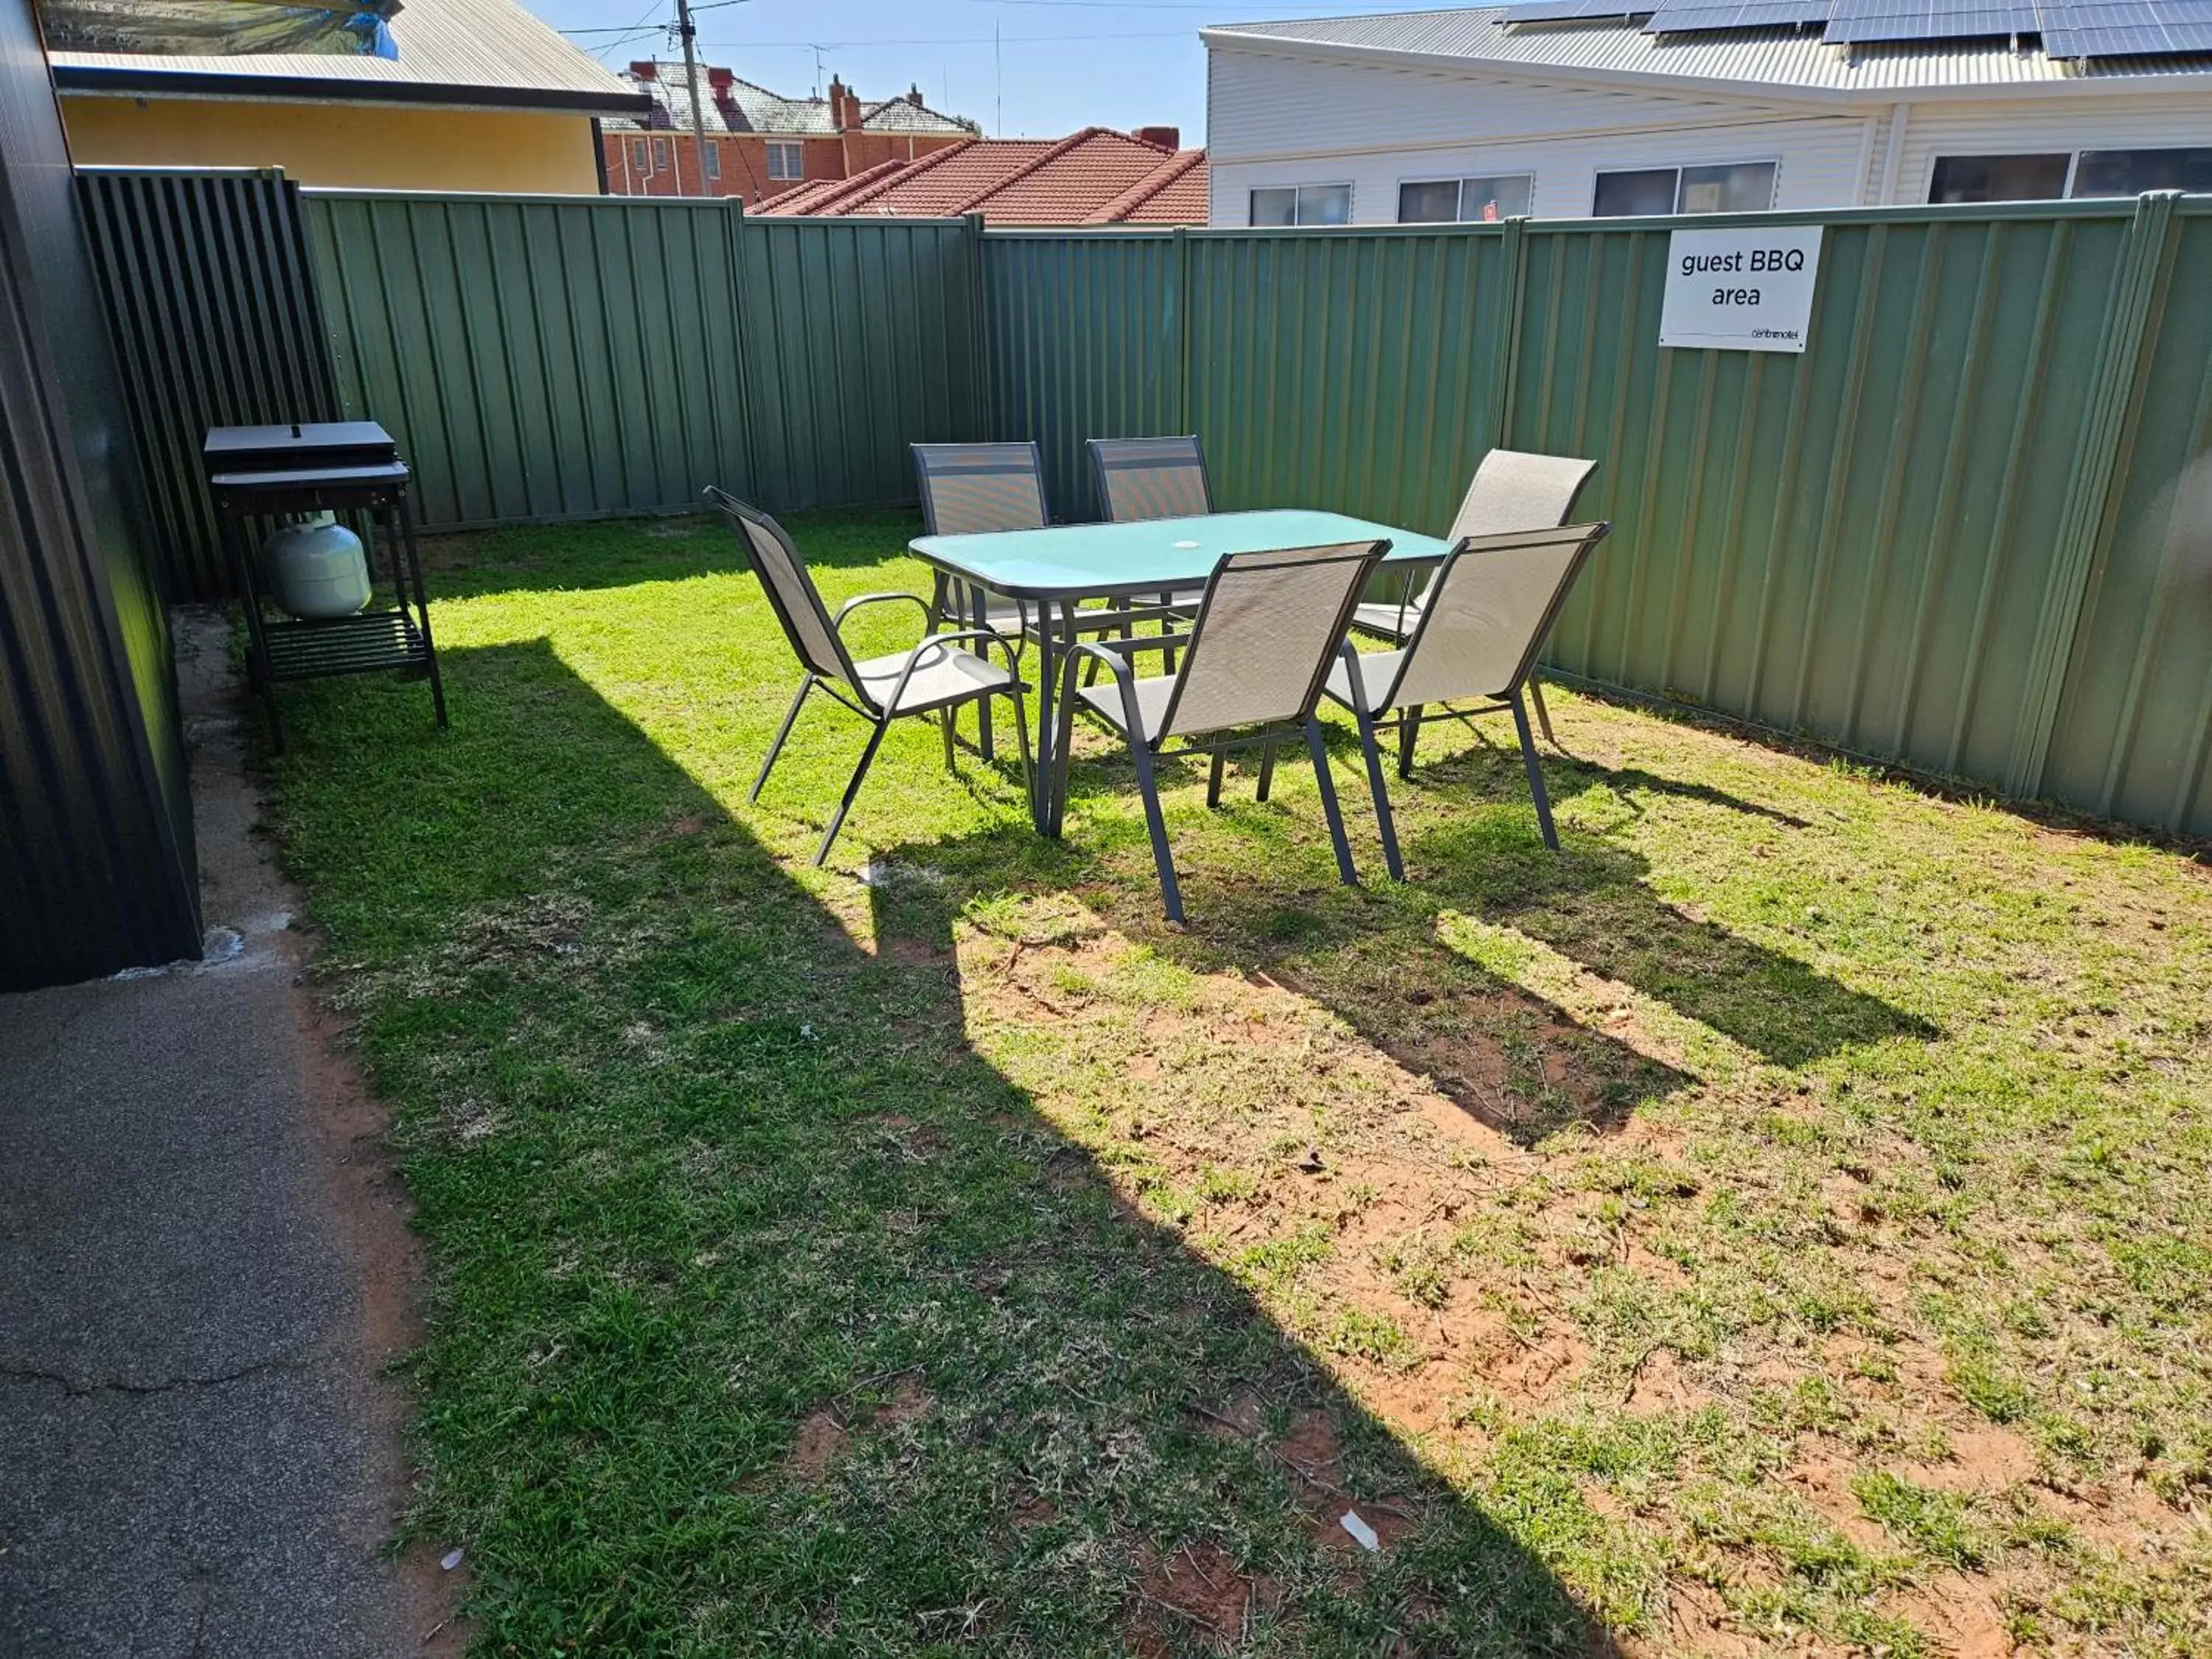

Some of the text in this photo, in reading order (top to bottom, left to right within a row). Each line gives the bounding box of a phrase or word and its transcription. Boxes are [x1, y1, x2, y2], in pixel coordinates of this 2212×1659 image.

[1682, 248, 1804, 276] guest BBQ
[1711, 288, 1761, 306] area
